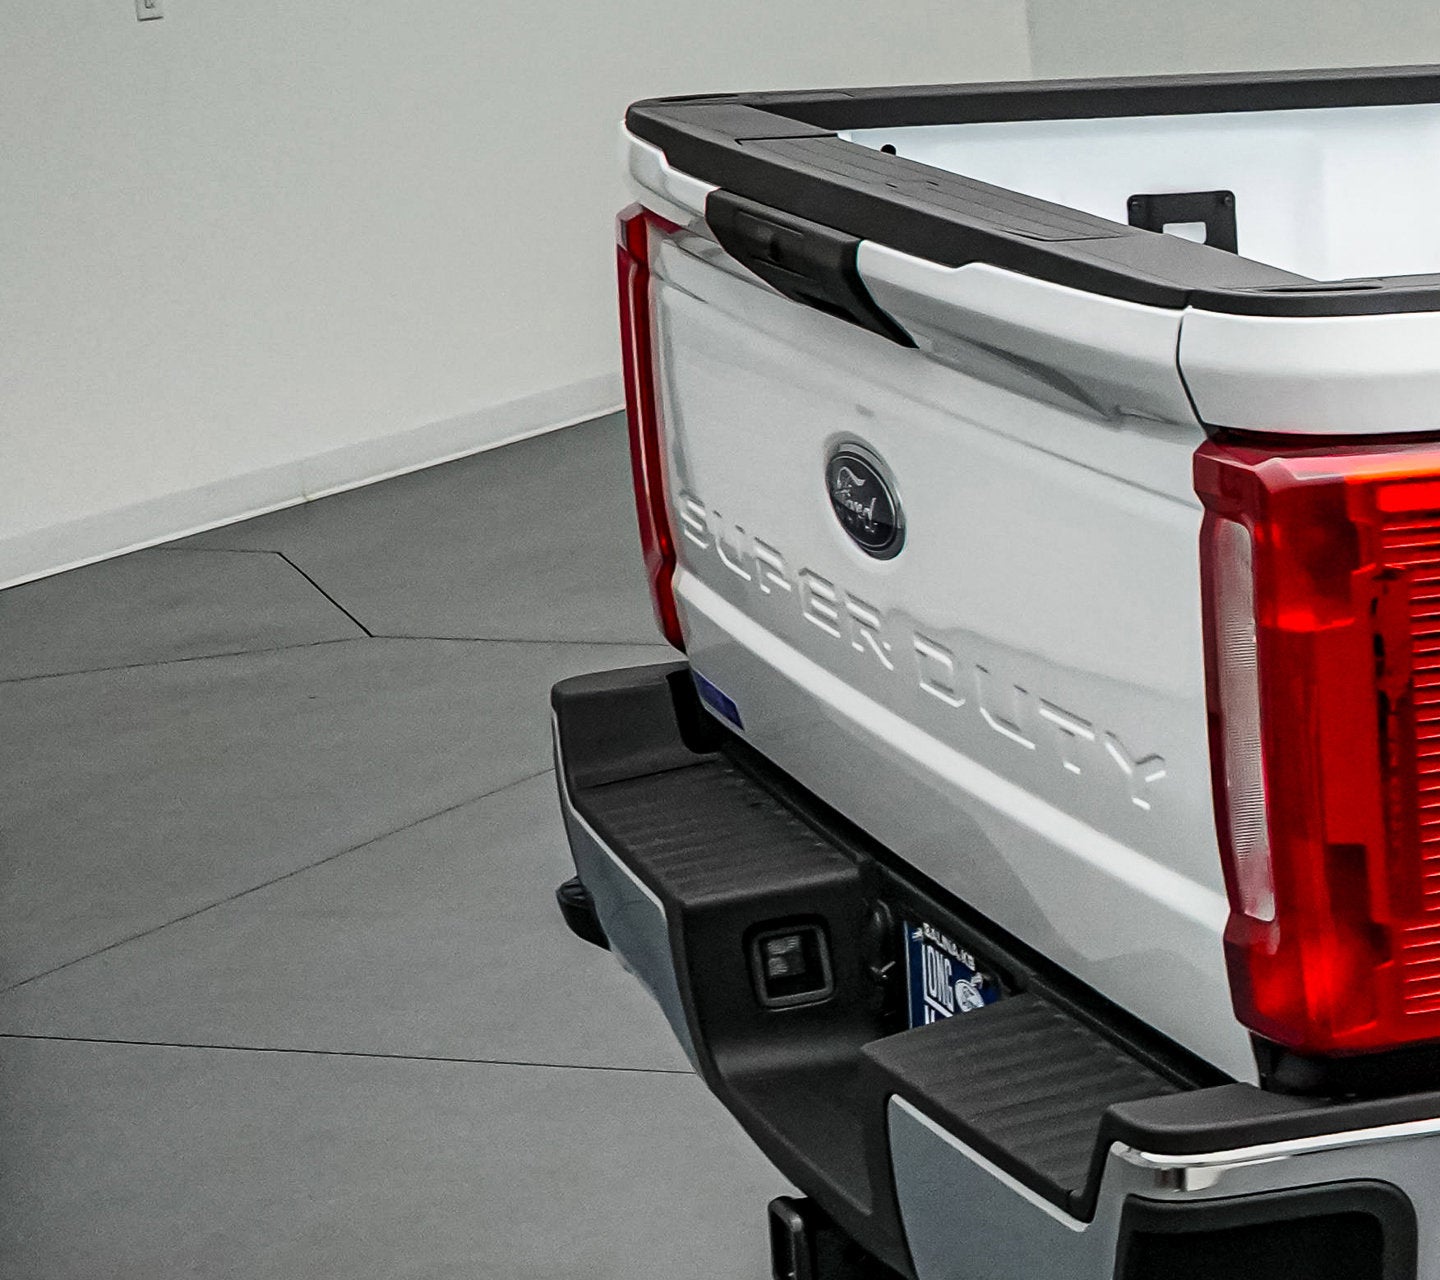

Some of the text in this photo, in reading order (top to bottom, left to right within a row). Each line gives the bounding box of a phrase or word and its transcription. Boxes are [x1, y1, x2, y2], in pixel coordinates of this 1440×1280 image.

[680, 490, 1167, 811] SUPER DUTY
[921, 943, 955, 1018] LONG
